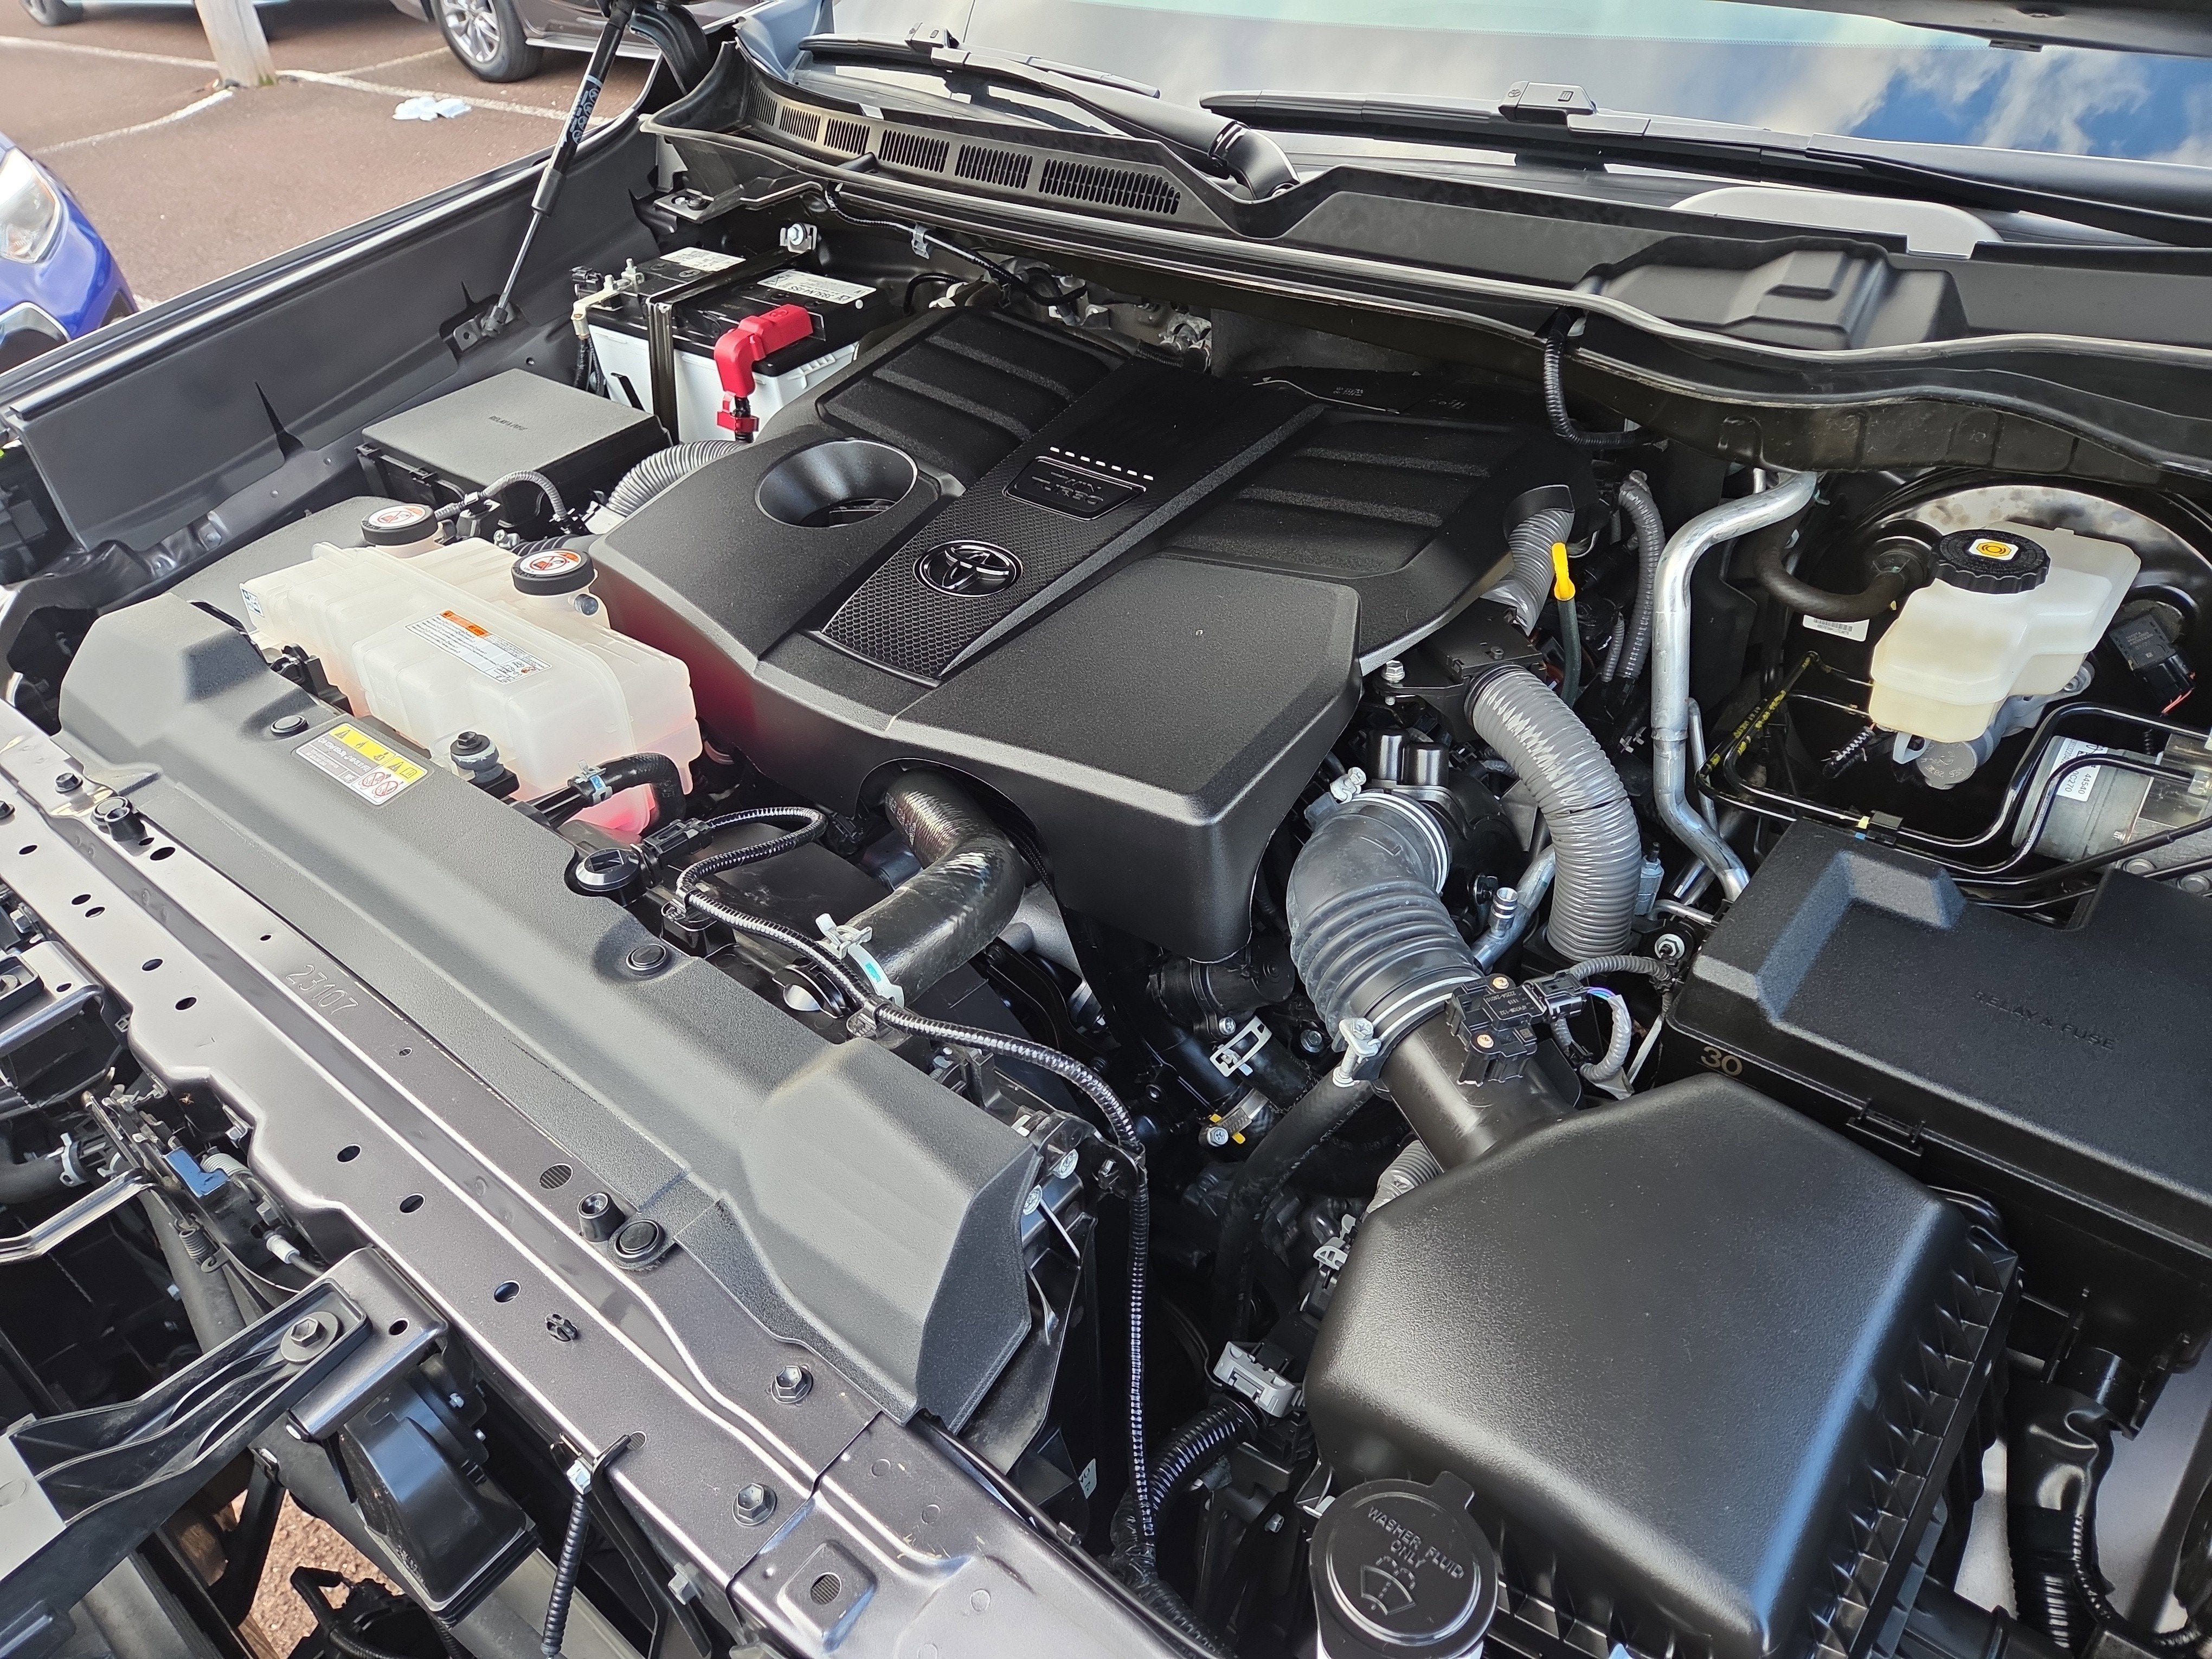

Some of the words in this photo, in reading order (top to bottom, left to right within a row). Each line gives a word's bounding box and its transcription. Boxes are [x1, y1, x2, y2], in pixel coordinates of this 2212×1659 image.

[2078, 773, 2091, 794] 44540
[286, 964, 359, 1015] 23107
[1971, 991, 2038, 1020] RELAY
[2061, 1024, 2114, 1051] FUSE
[1701, 1046, 1742, 1076] 30
[1368, 1507, 1422, 1551] WASHER
[1425, 1546, 1464, 1578] FLUID
[1391, 1539, 1426, 1568] ONLY
